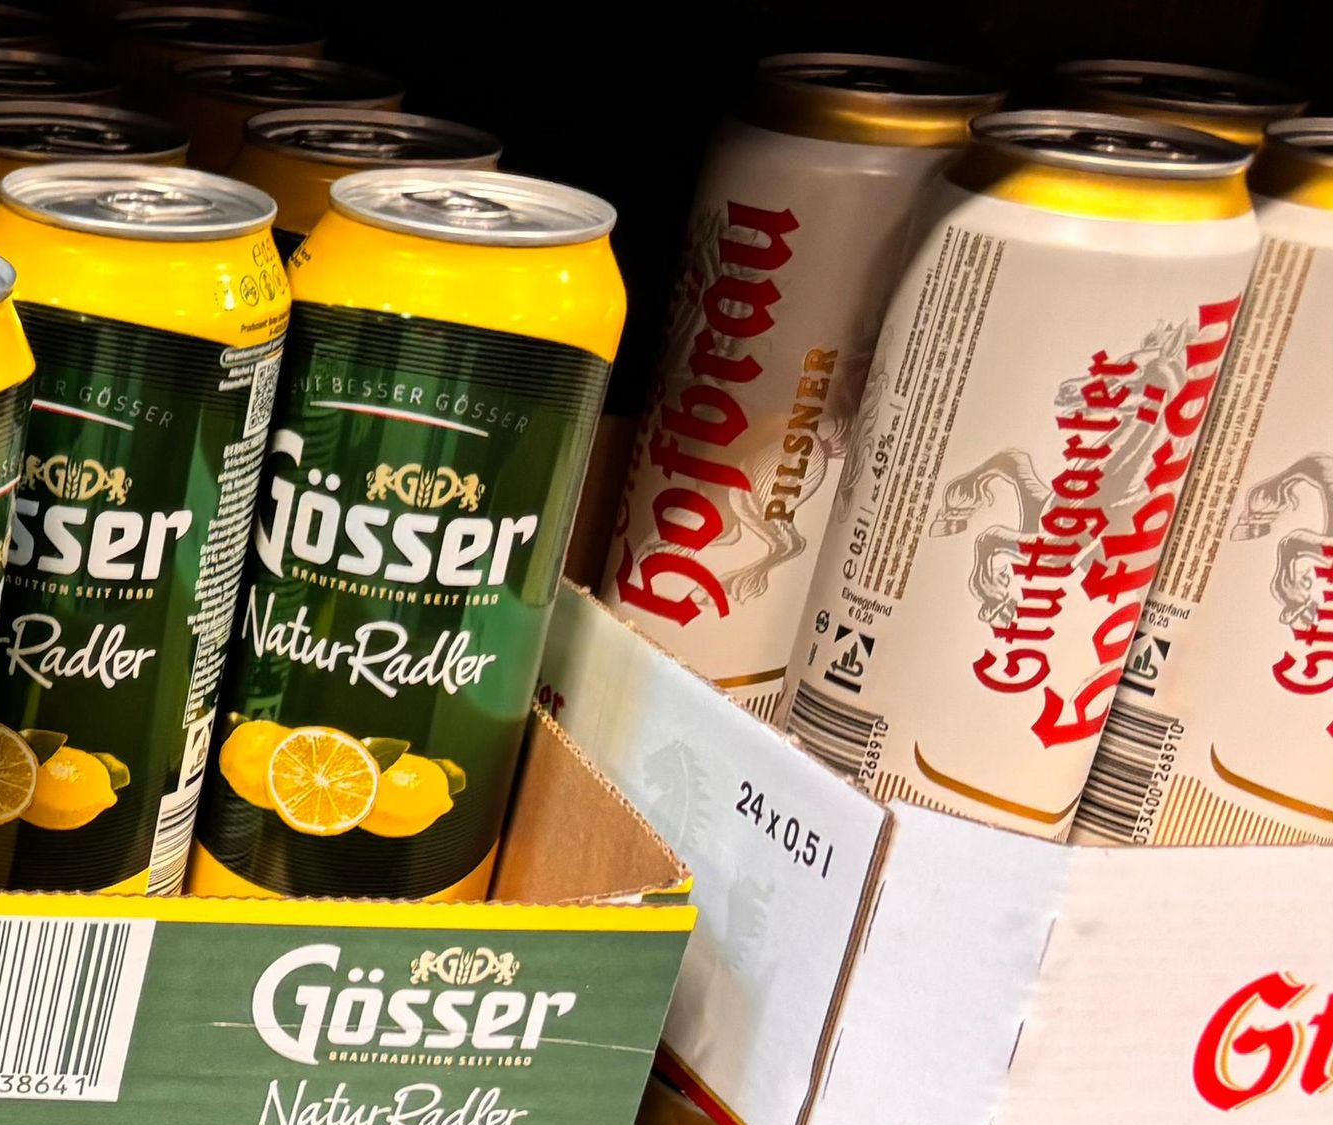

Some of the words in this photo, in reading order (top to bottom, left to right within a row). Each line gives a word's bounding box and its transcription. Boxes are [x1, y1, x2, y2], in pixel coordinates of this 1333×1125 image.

[331, 377, 424, 404] BESSER
[435, 391, 529, 431] GÖSSER
[616, 200, 801, 627] Hofbräu
[764, 347, 838, 524] PILSNER
[255, 429, 538, 587] Gösser
[973, 349, 1136, 694] Stuttgarter
[1032, 293, 1243, 750] Hofbräu
[291, 567, 416, 603] BRAUTRADITION
[423, 593, 460, 606] SEIT
[1154, 723, 1184, 781] 268910
[737, 781, 765, 820] 24
[765, 815, 781, 838] x
[784, 820, 821, 868] 0,5
[251, 944, 578, 1065] Gösser
[330, 1050, 454, 1067] BRAUTRADITION
[457, 1054, 493, 1067] SEIT
[497, 1054, 533, 1067] 1860
